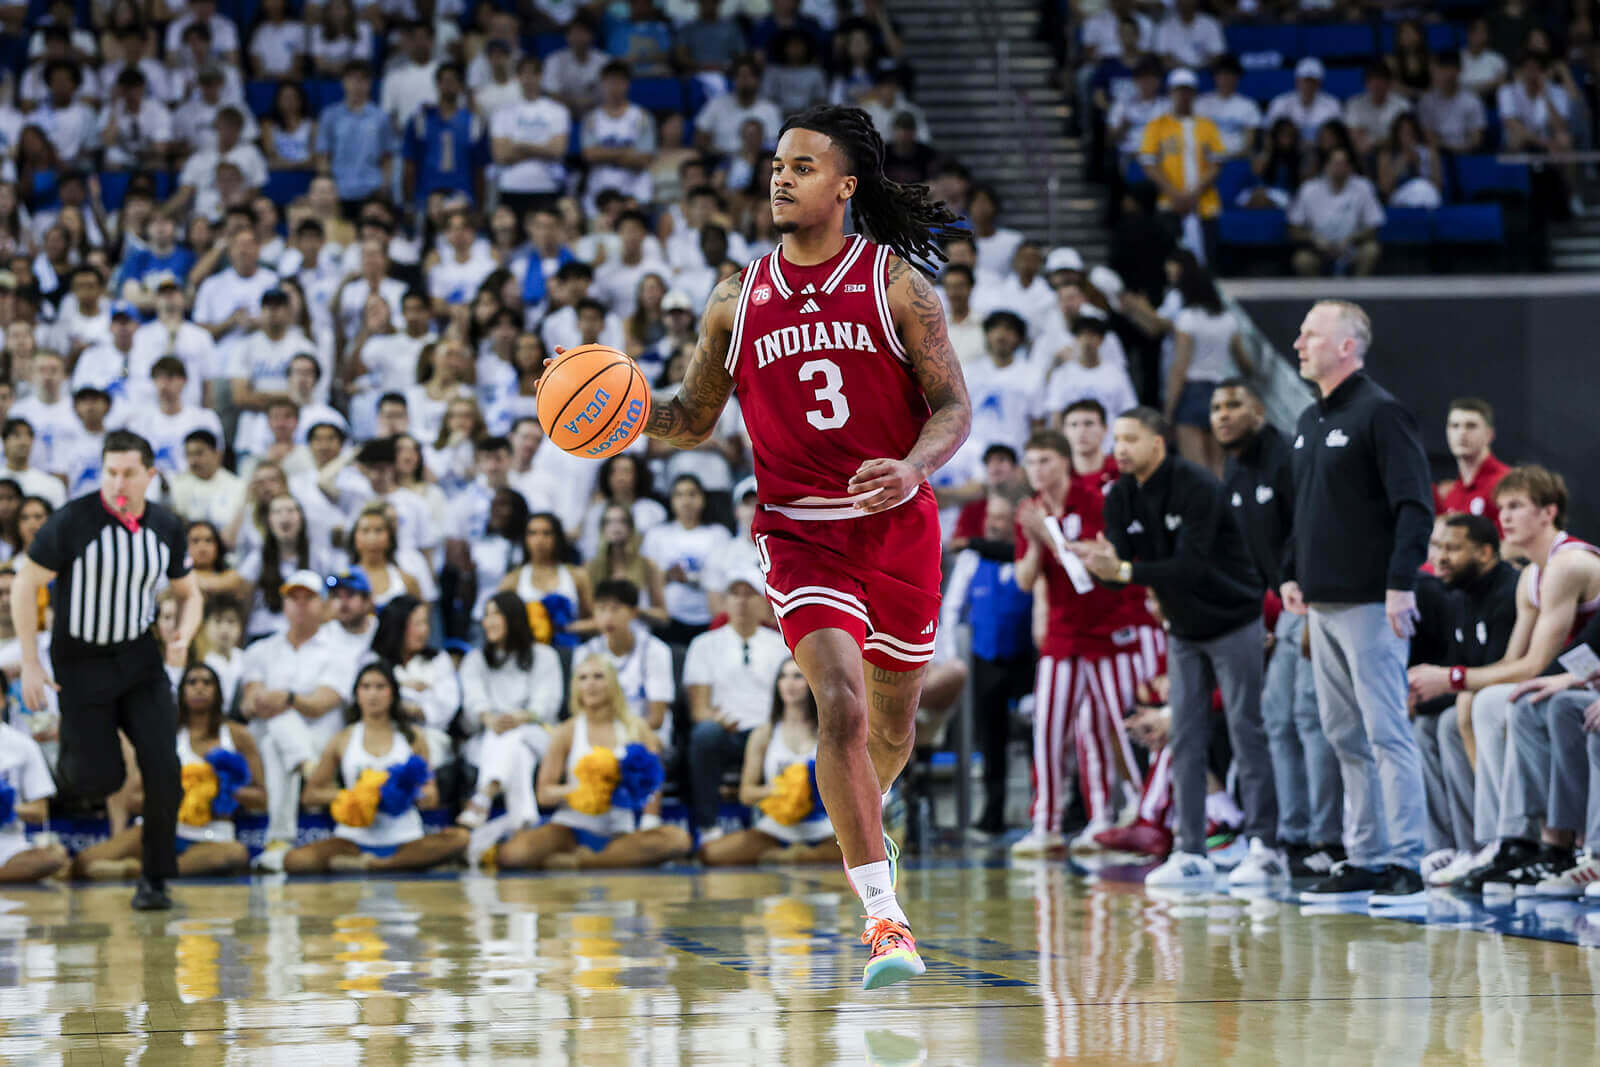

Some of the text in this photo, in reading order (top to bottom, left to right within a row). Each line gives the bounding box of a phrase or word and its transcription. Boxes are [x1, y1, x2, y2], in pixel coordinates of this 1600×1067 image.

[754, 321, 877, 369] INDIANA
[563, 388, 611, 434] UCLA
[798, 358, 850, 431] 3
[586, 398, 644, 455] Wilson
